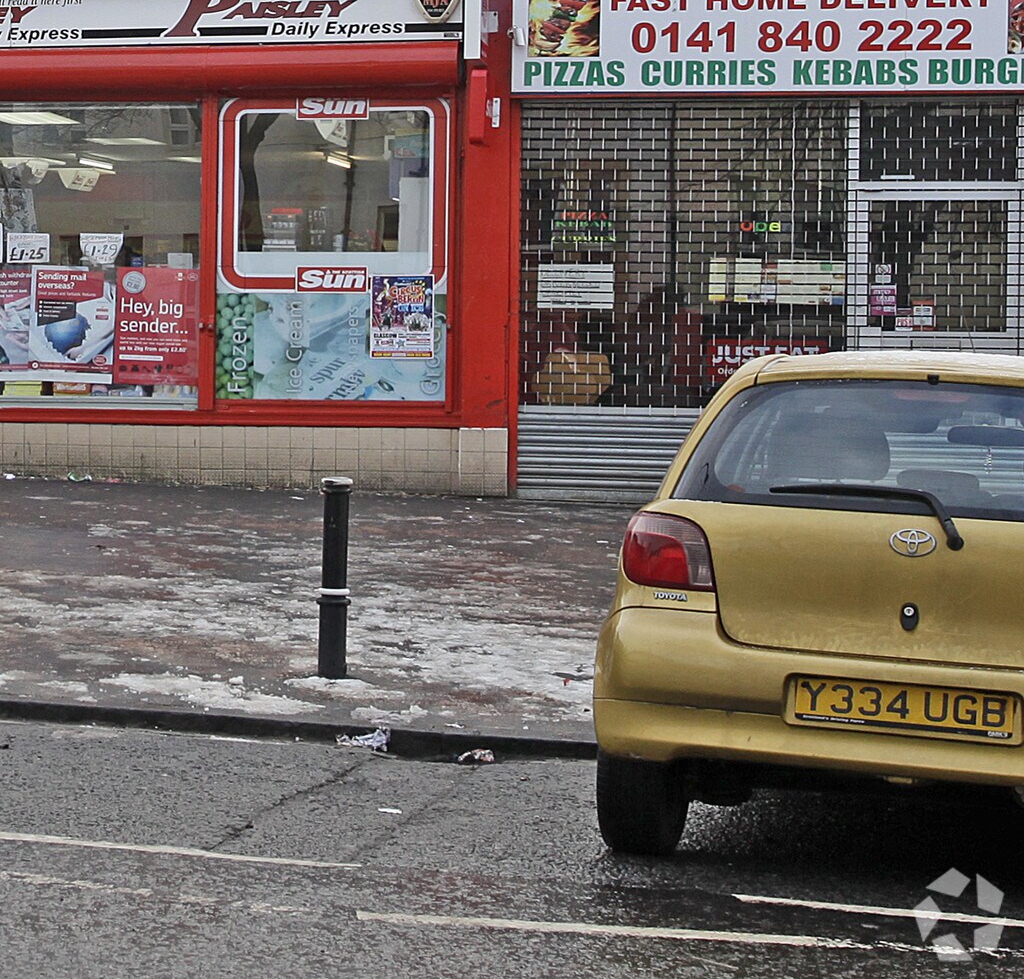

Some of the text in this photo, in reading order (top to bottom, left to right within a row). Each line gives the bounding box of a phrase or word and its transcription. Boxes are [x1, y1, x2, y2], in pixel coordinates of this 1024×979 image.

[8, 28, 81, 42] Express
[271, 21, 404, 38] Daily Express
[631, 19, 973, 53] 0141 840 2222
[524, 57, 1024, 86] PIZZAS CURRIES KEBABS BURG
[299, 97, 366, 115] Sun
[38, 271, 87, 281] Sending mail
[298, 269, 365, 289] Sun
[38, 282, 75, 290] overseas?
[389, 285, 422, 298] CIRCUS
[120, 297, 184, 319] Hey, big
[120, 317, 189, 334] sender...
[228, 317, 247, 393] Frozen
[286, 300, 303, 394] Ice Cream
[712, 345, 770, 364] JUST
[654, 591, 688, 602] TOYOTA
[801, 680, 1009, 728] Y334 UGB
